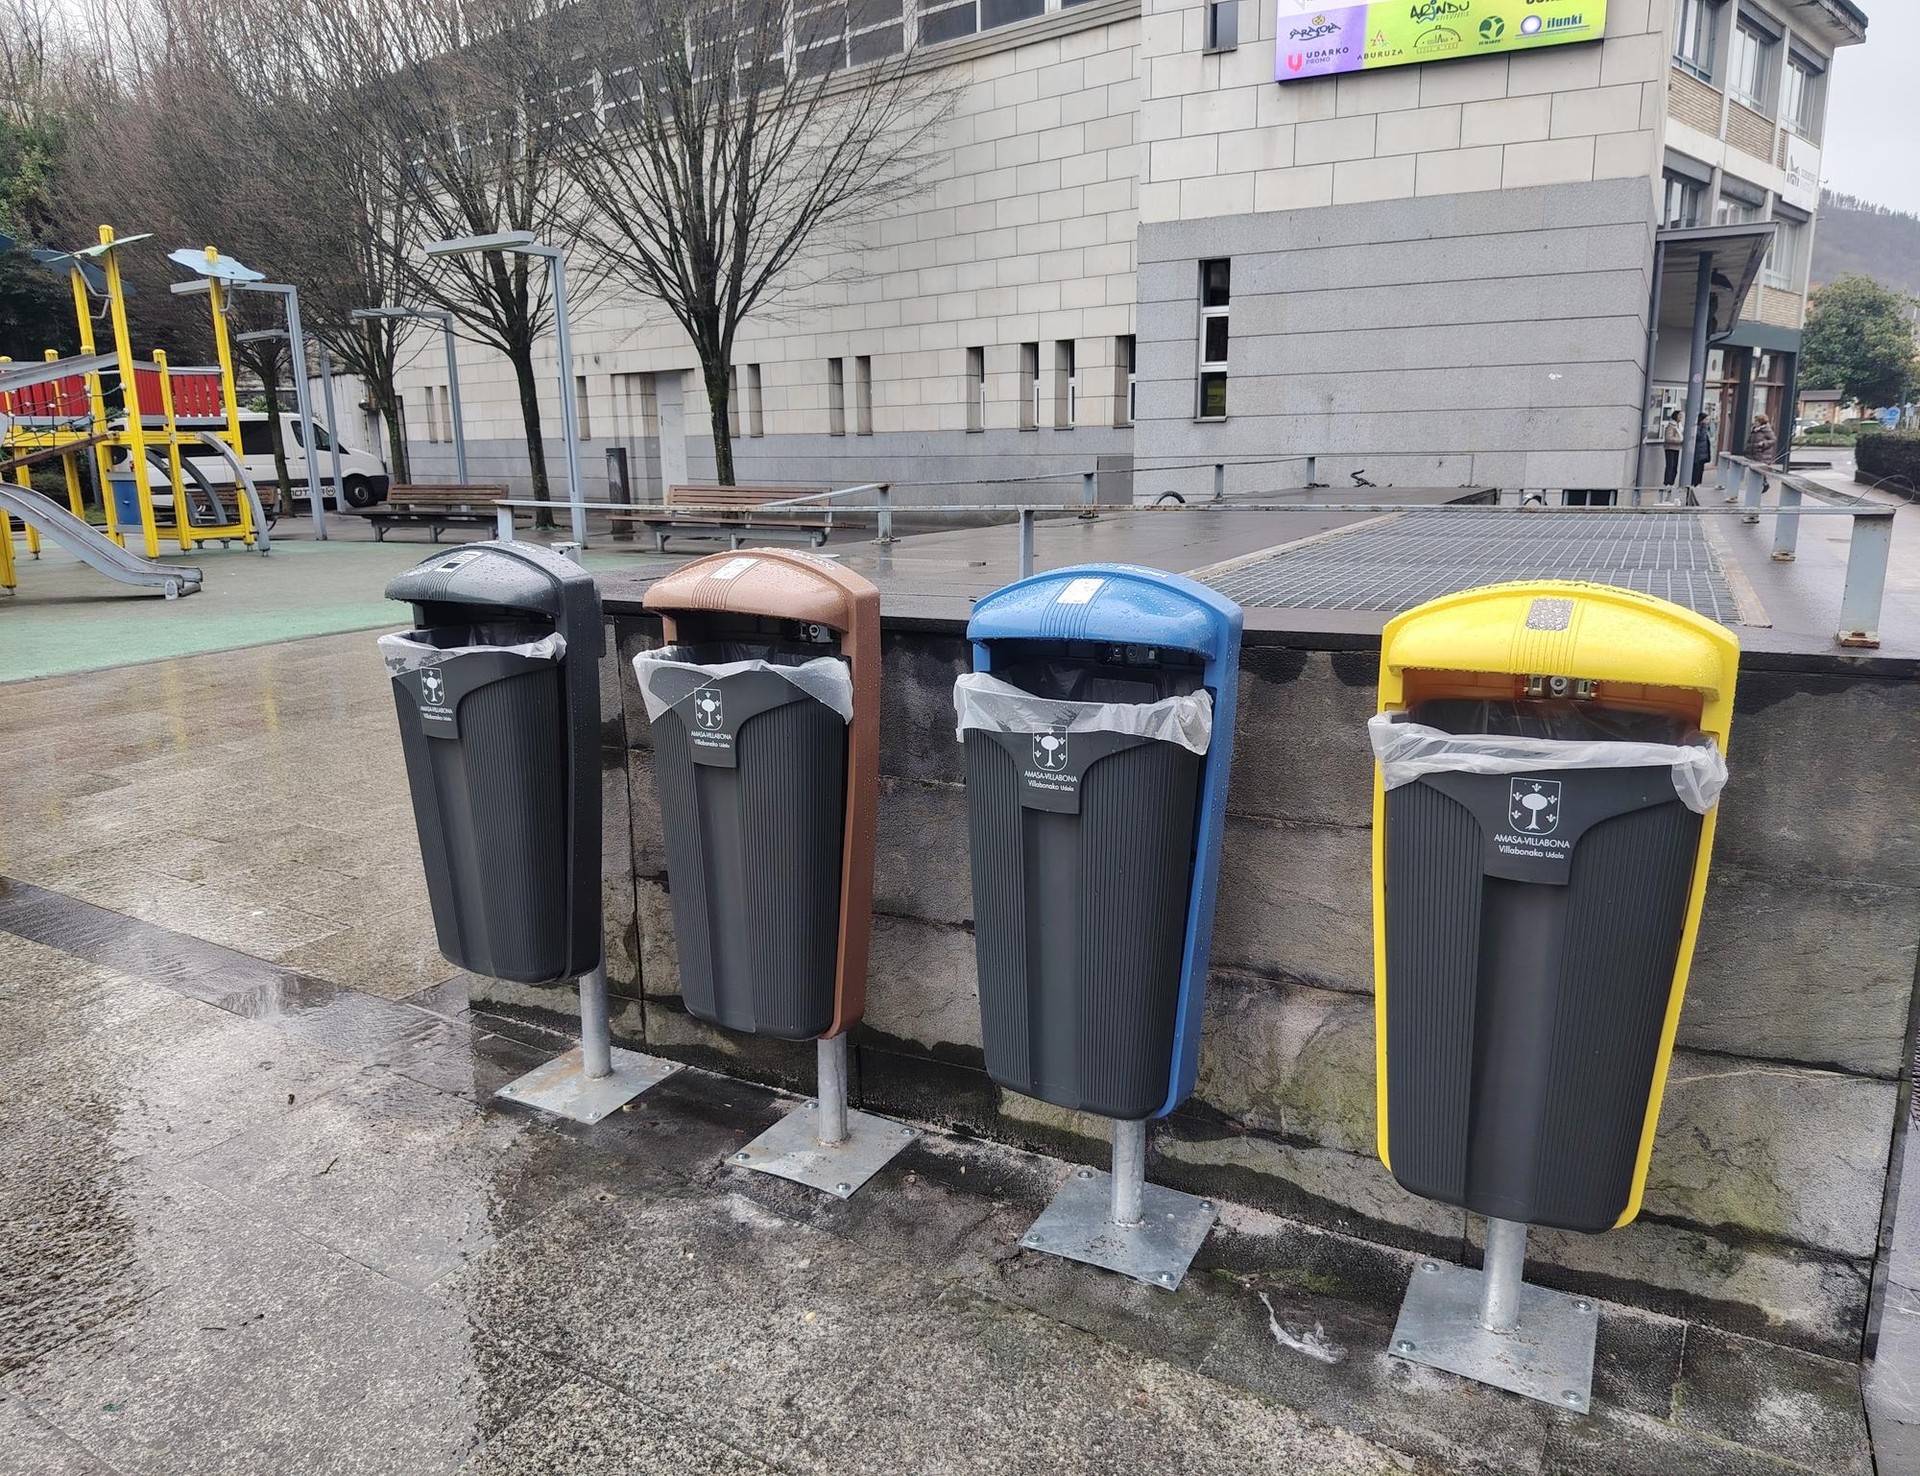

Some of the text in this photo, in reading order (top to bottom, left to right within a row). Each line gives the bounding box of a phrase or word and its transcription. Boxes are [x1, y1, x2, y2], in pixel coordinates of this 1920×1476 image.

[1547, 14, 1582, 28] ilunki
[1306, 46, 1349, 58] UDARKO
[1357, 48, 1404, 60] ABURUZA
[1305, 57, 1331, 65] PROMO
[1024, 771, 1077, 782] AMASA-VILLABONA
[1028, 780, 1059, 790] Villabonako
[1494, 834, 1570, 848] AMASA-VILLABONA
[1498, 845, 1544, 858] Villabonako
